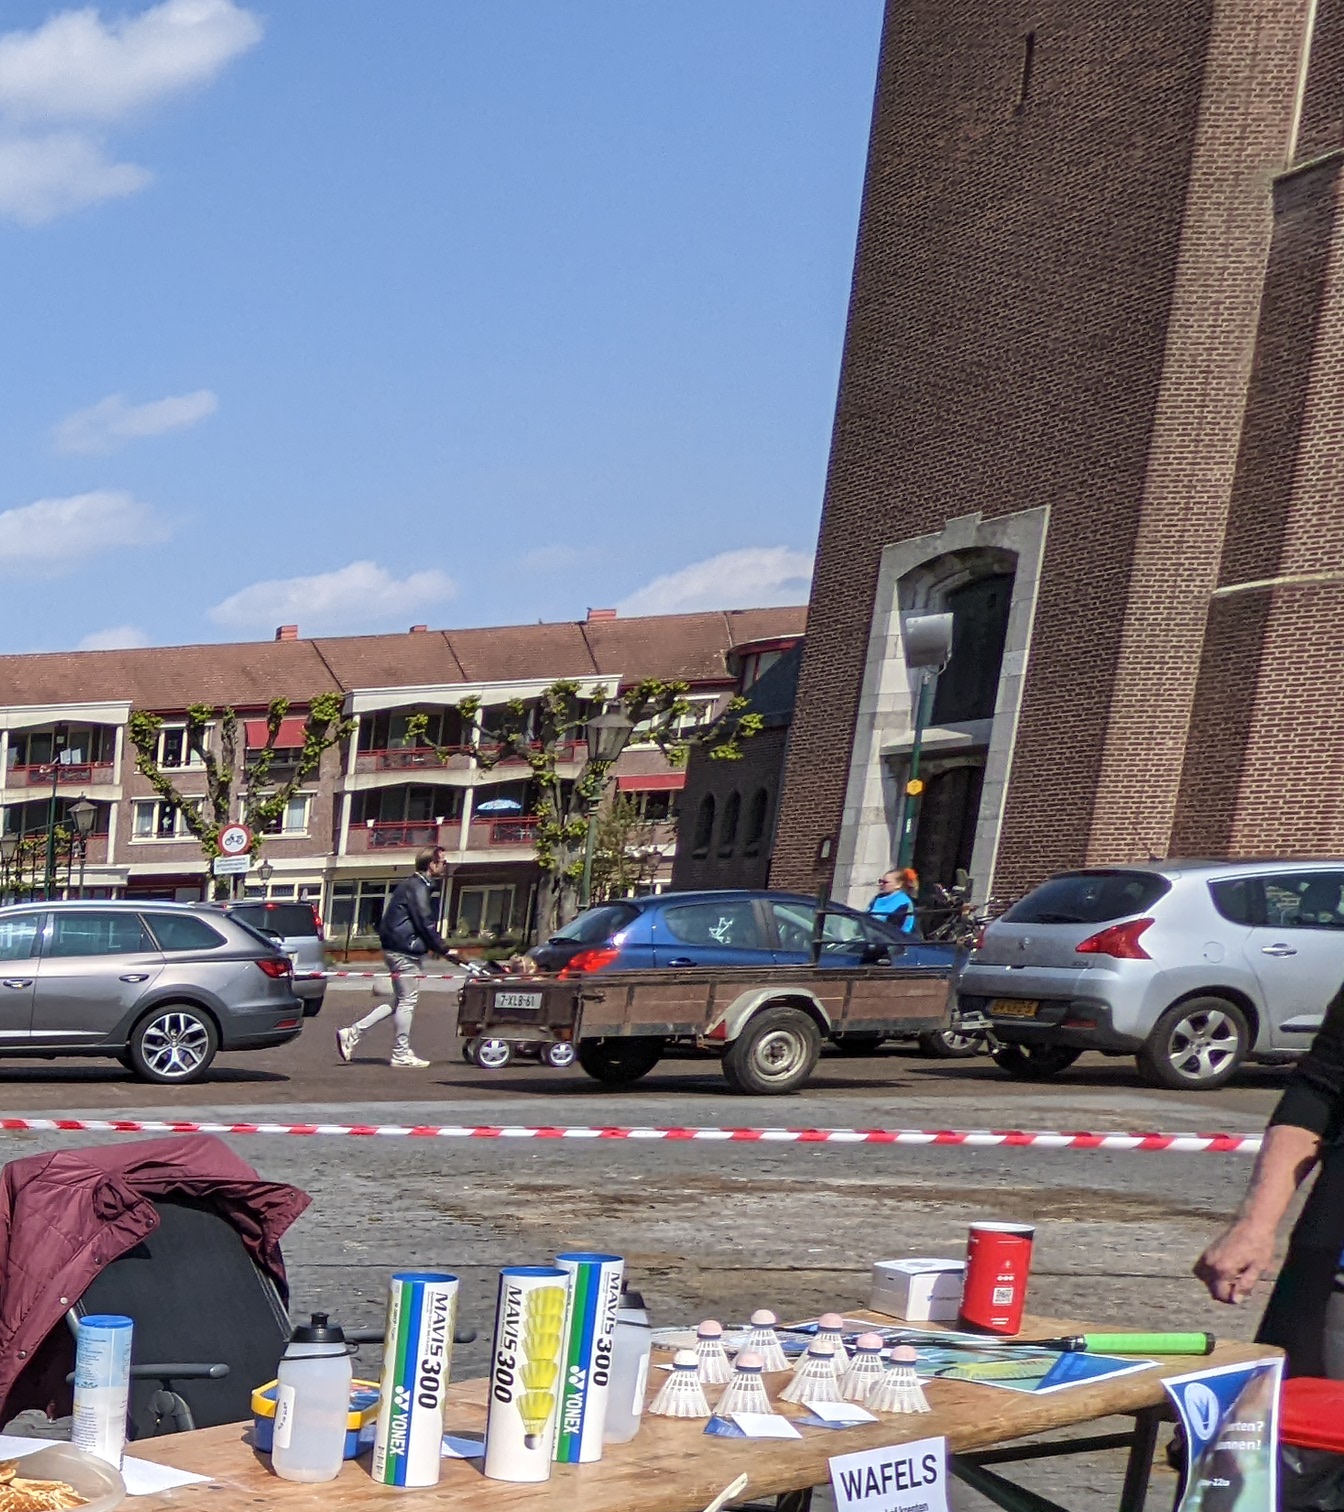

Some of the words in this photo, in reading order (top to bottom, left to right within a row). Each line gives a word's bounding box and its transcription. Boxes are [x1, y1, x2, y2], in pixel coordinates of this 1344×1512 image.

[430, 1292, 449, 1356] MAVIS
[503, 1285, 523, 1352] MAVIS
[602, 1272, 621, 1336] MAVIS
[418, 1358, 441, 1410] 300
[494, 1351, 516, 1404] 300
[593, 1337, 613, 1387] 300
[390, 1412, 409, 1456] YONEX
[563, 1392, 582, 1435] YONEX
[840, 1454, 938, 1502] WAFELS
